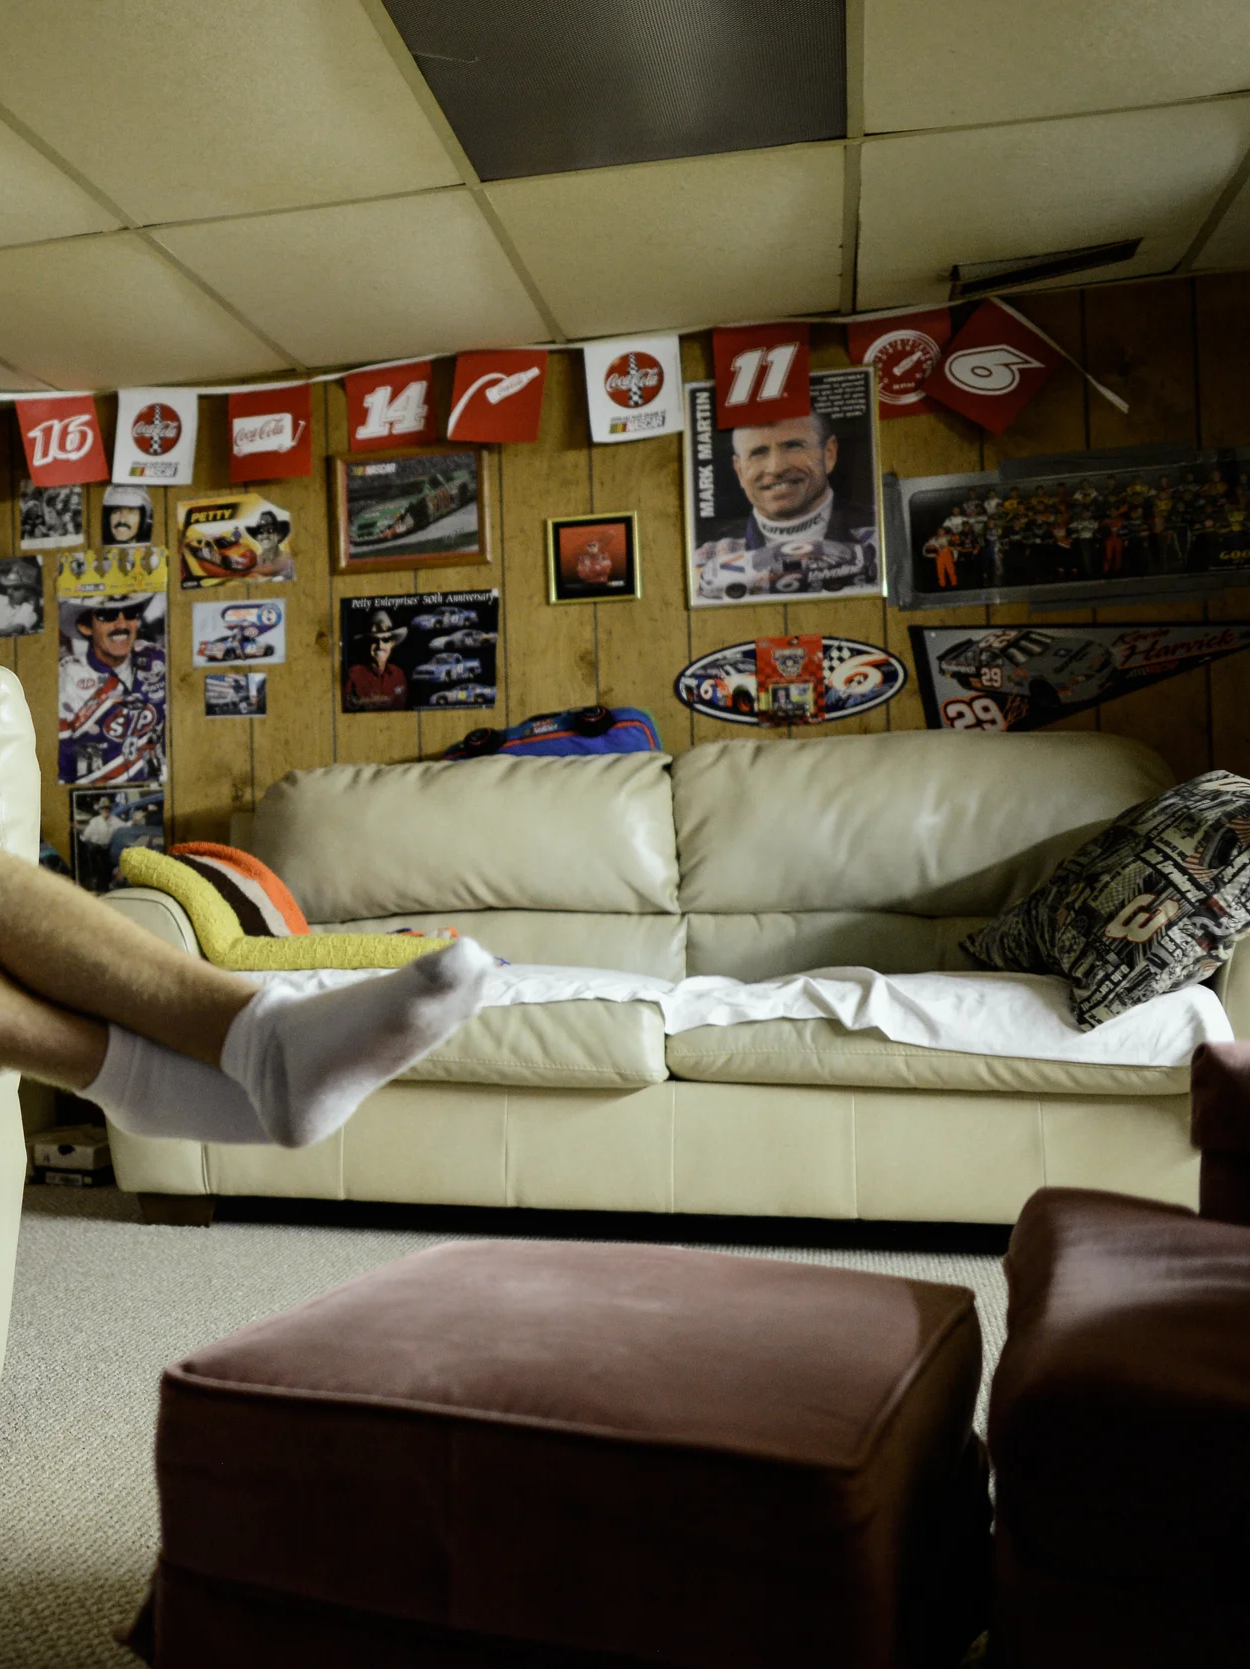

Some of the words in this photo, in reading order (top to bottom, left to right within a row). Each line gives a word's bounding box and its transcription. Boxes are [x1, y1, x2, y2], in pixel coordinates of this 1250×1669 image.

[725, 341, 800, 407] 11
[355, 381, 429, 440] 14
[695, 391, 714, 460] MARTIN
[26, 414, 94, 467] 16
[698, 464, 715, 518] MARK
[191, 508, 232, 524] PETTY
[351, 598, 371, 612] Petty
[422, 592, 443, 605] 50th
[1121, 628, 1235, 667] Harvick
[829, 652, 892, 696] 6
[979, 665, 1002, 688] 29
